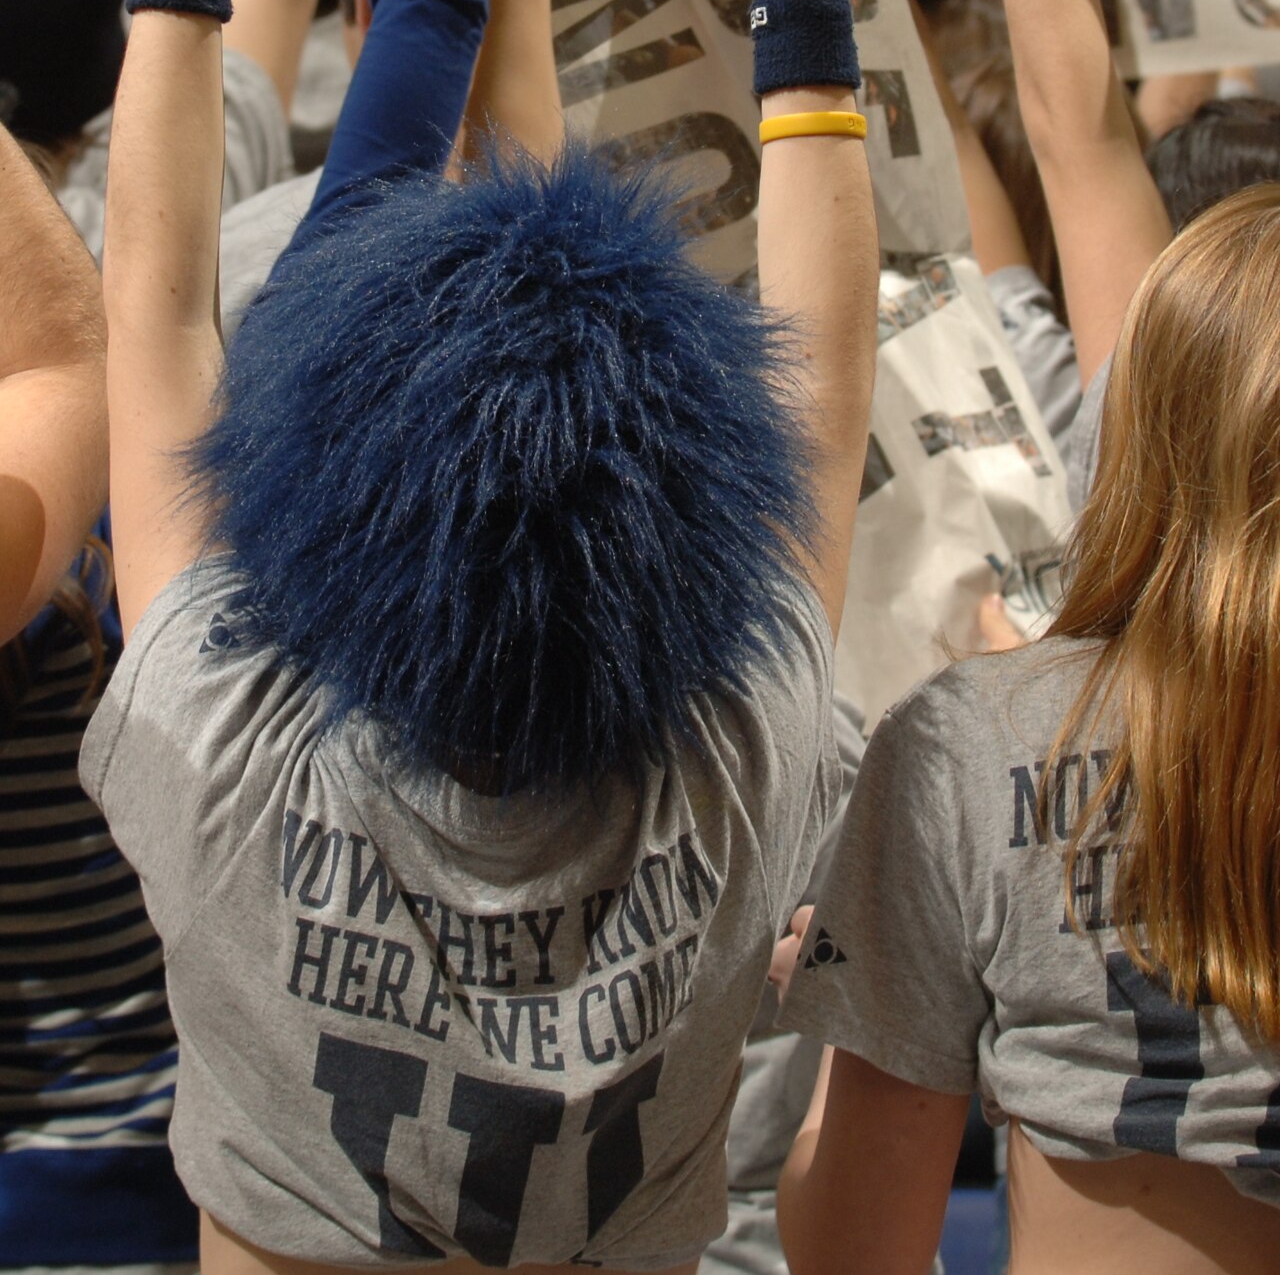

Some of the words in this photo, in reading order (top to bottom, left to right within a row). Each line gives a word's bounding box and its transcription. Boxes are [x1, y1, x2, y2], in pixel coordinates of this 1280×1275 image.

[280, 808, 402, 925] NOW
[580, 830, 722, 974] KNOW
[286, 917, 456, 1042] HERE
[578, 933, 700, 1067] COME
